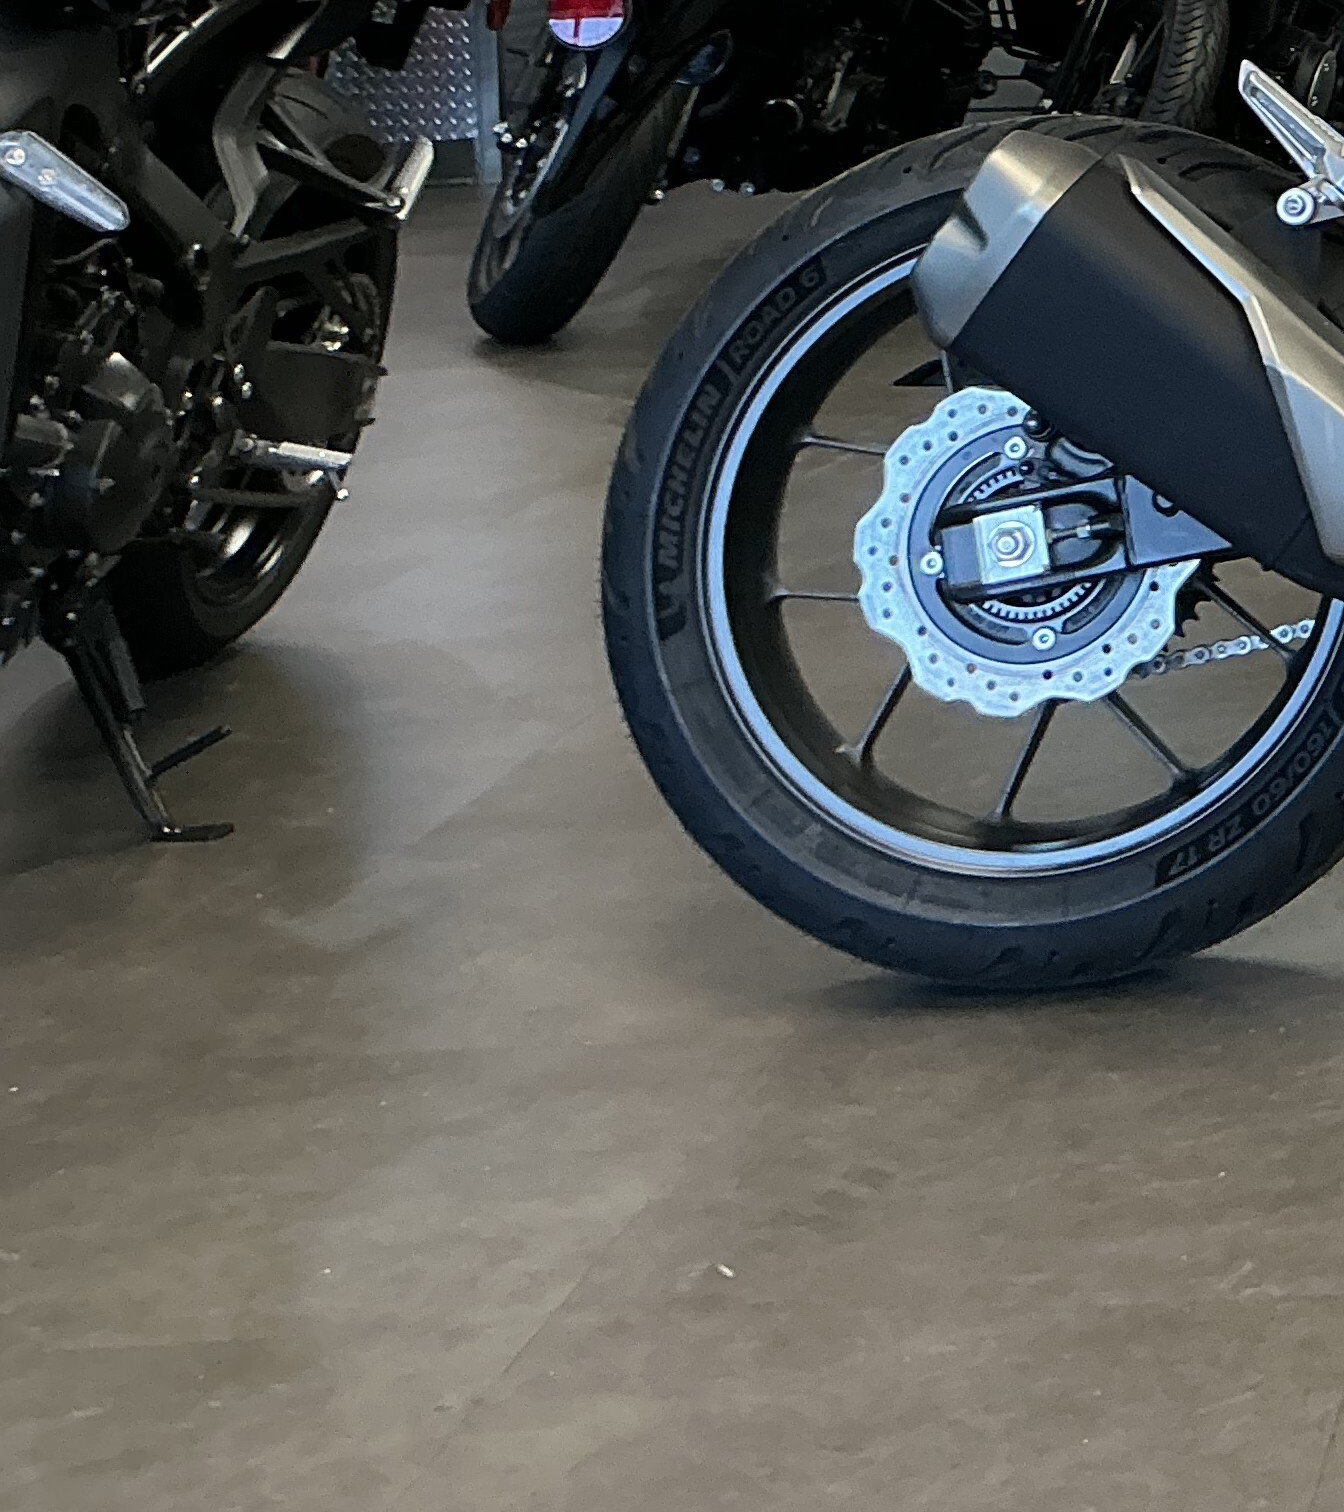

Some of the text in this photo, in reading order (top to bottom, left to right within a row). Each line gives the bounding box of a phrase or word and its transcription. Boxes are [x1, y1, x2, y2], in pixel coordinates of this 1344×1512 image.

[656, 385, 723, 570] MICHELIN
[727, 287, 797, 366] ROAD
[1250, 721, 1336, 817] 160/60
